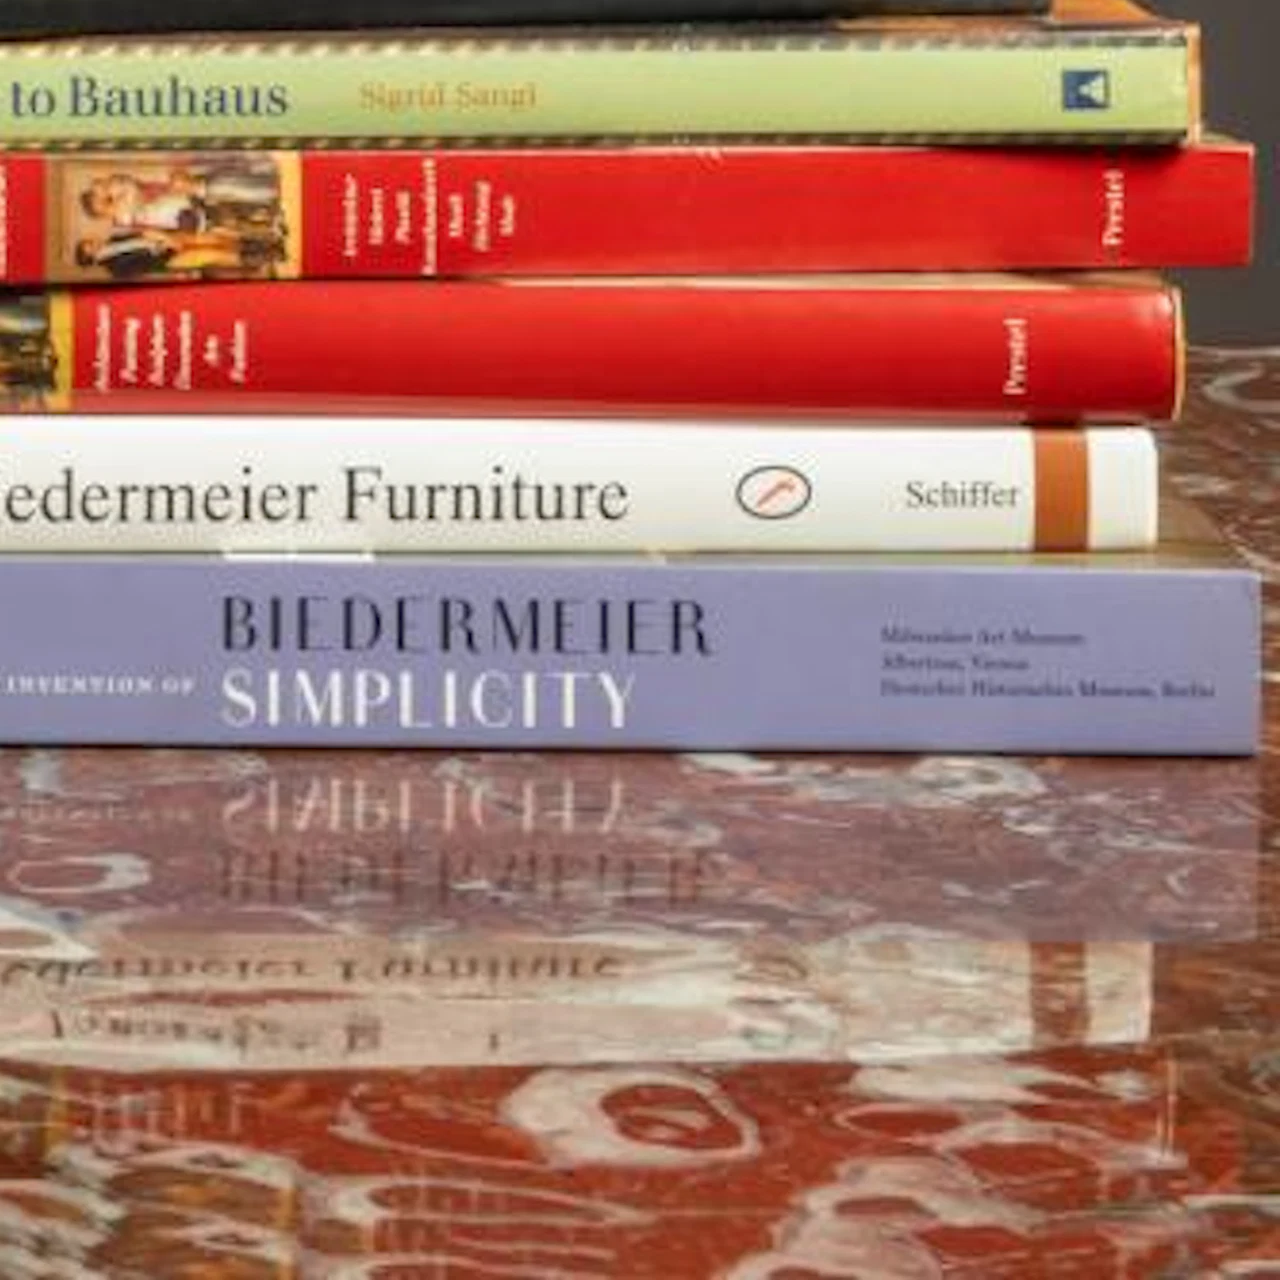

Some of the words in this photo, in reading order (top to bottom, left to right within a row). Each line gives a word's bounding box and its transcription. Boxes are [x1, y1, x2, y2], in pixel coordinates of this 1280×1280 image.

[11, 81, 57, 119] to
[69, 75, 290, 118] Bauhaus
[358, 79, 446, 115] Sigrid
[1101, 171, 1125, 247] Prestel
[1002, 317, 1028, 395] Prestel
[344, 465, 628, 523] Furniture
[905, 480, 1019, 509] Schiffer
[222, 595, 708, 656] BIEDERMEIER
[6, 674, 153, 695] INVENTION
[221, 668, 628, 729] SIMPLICITY
